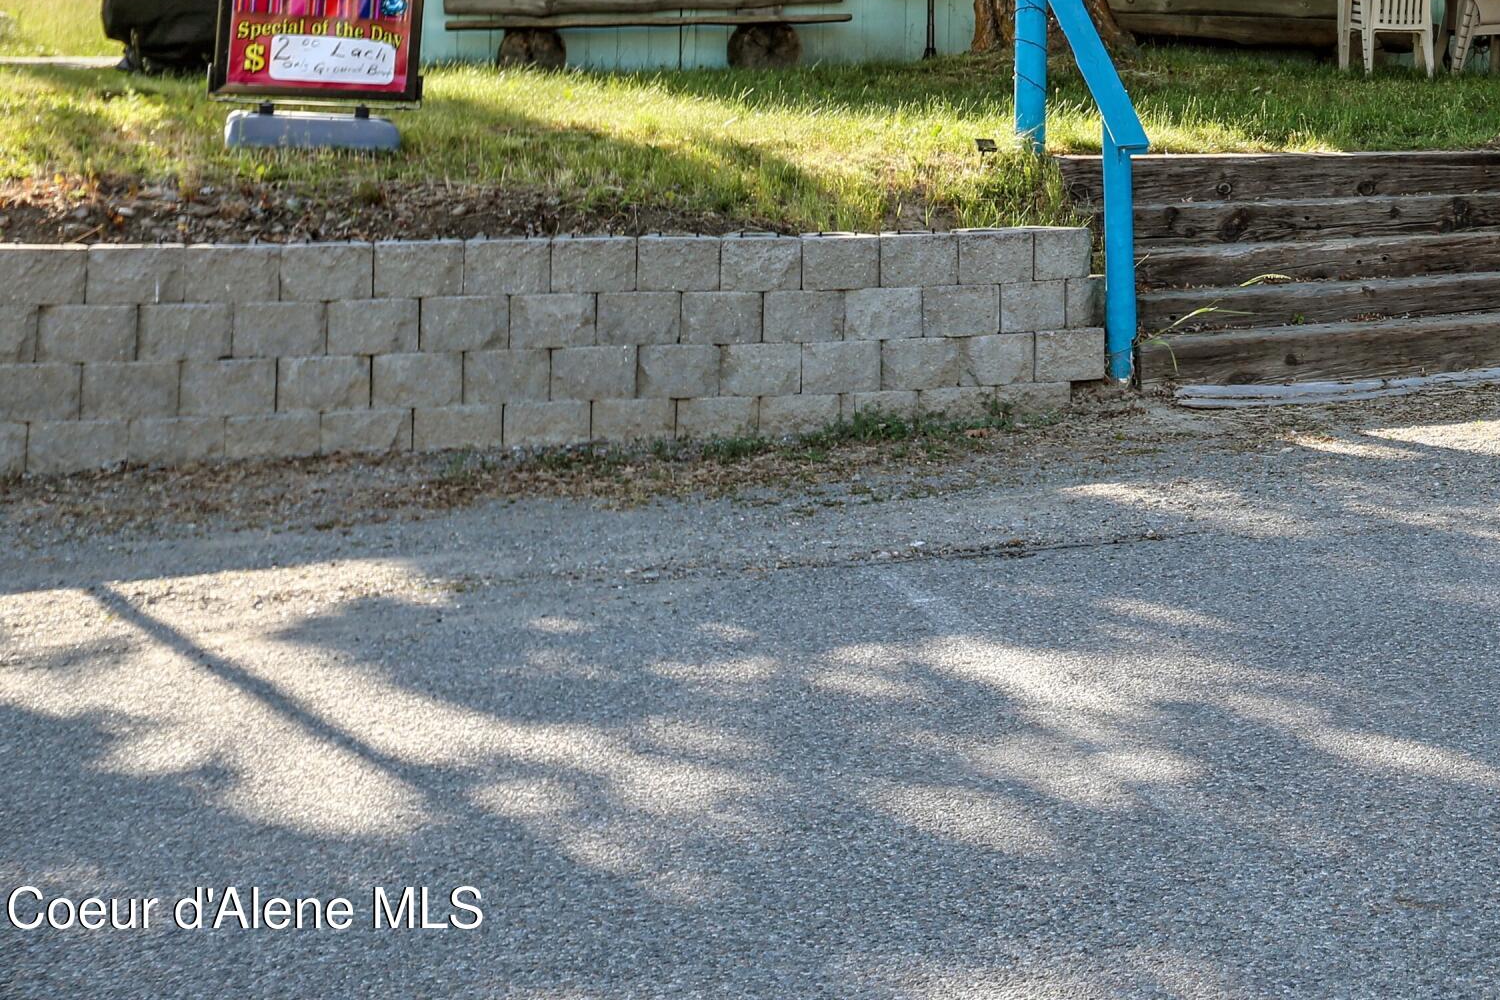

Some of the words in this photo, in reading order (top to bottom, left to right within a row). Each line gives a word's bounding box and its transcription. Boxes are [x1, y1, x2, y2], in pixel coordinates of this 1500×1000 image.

[237, 19, 304, 40] Special
[311, 19, 329, 35] of
[335, 21, 364, 39] the
[370, 25, 404, 49] Day
[244, 42, 265, 74] $
